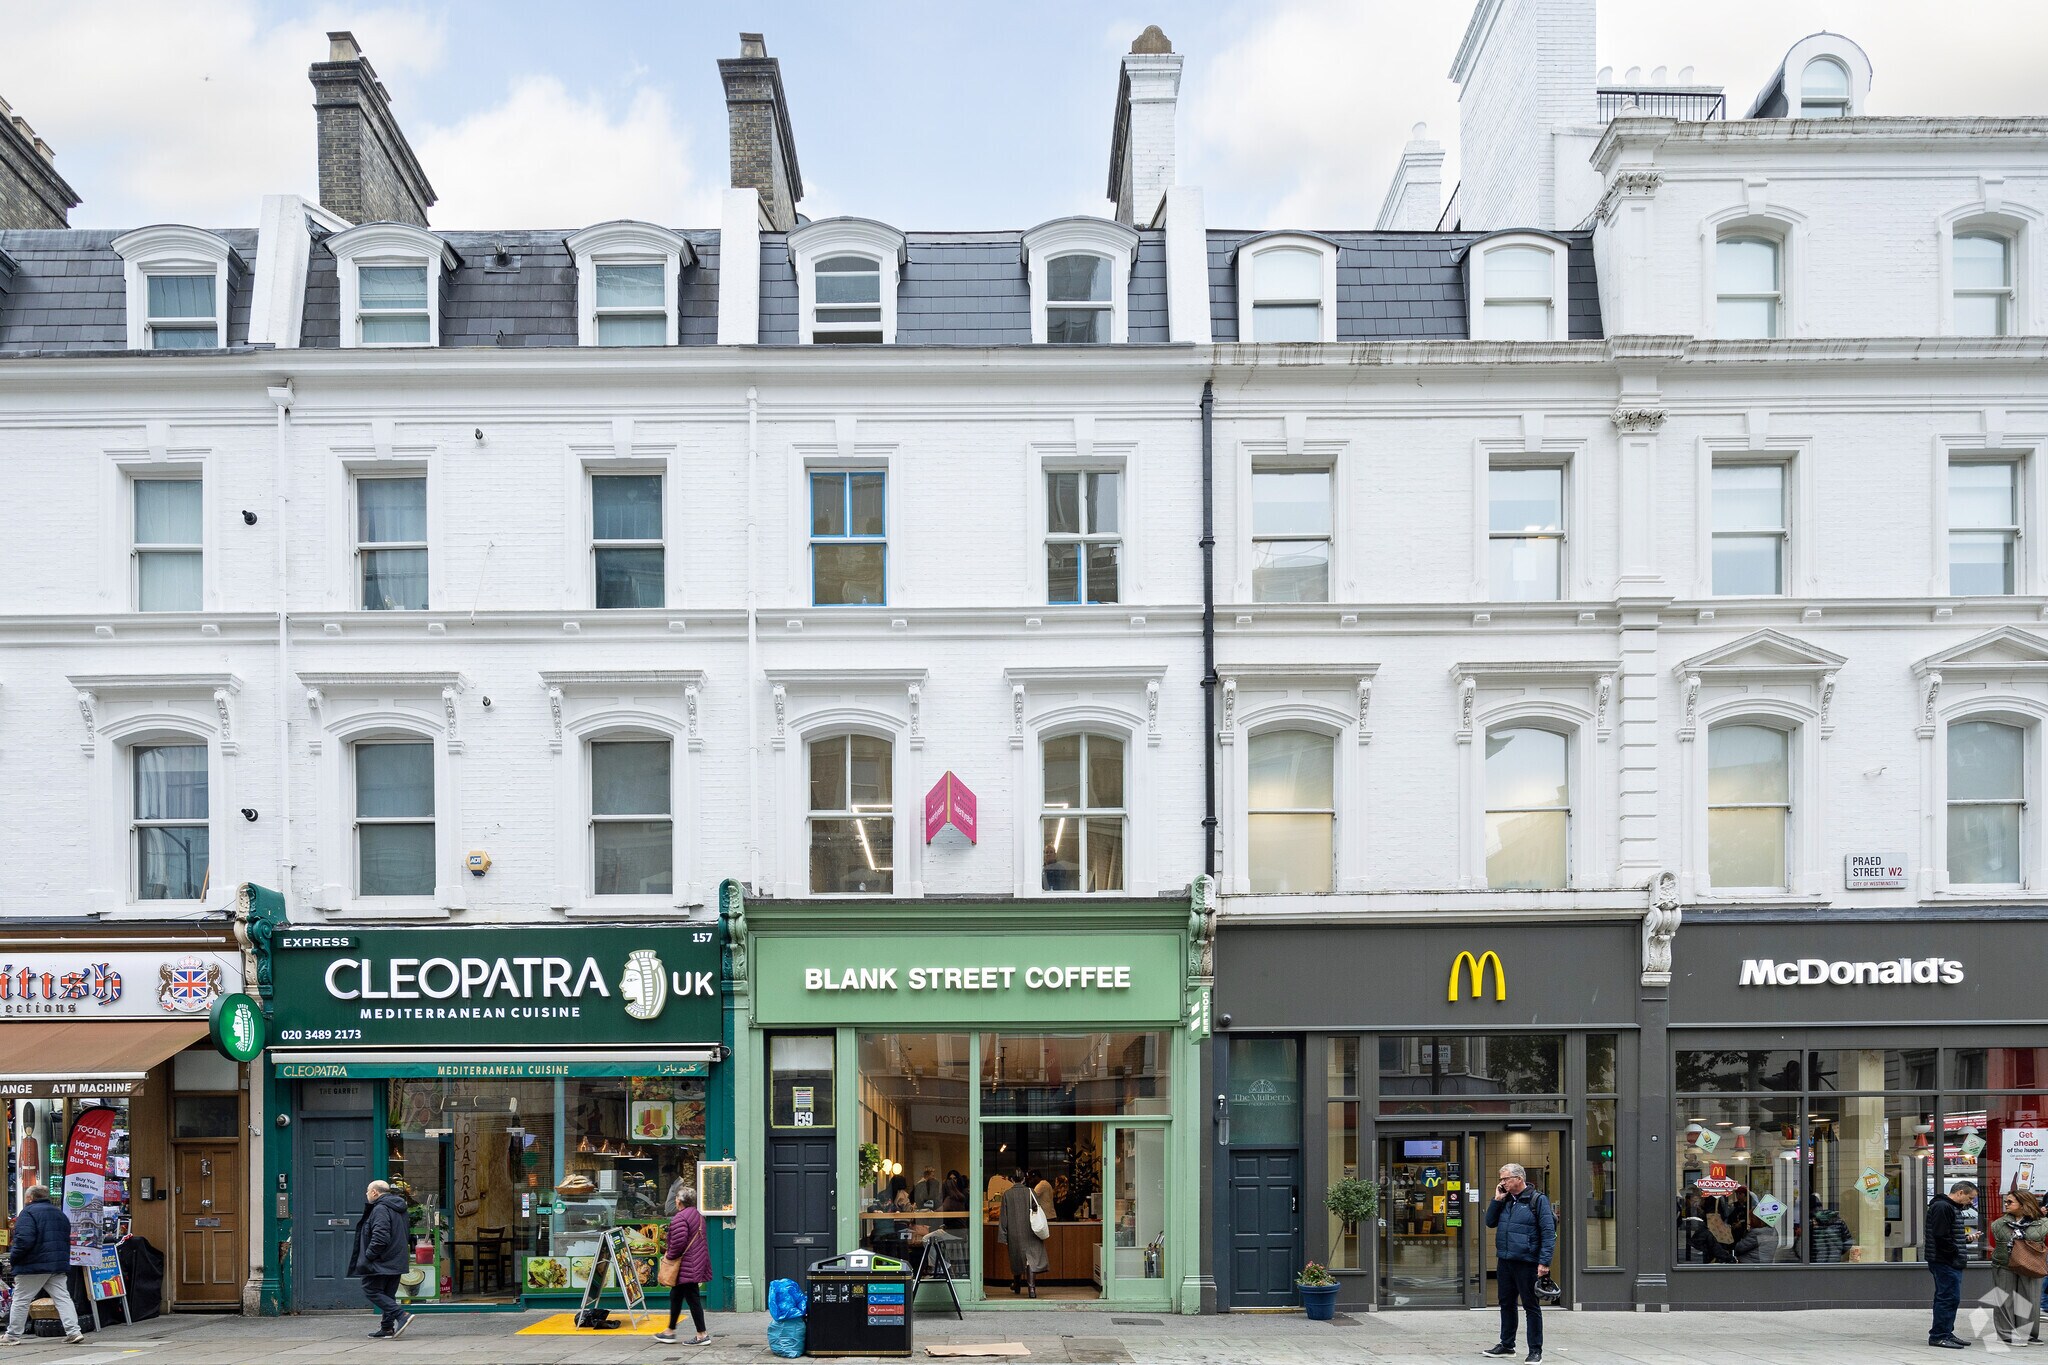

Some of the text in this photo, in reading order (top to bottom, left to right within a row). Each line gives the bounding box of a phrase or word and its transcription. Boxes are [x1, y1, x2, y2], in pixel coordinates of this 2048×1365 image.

[1852, 856, 1882, 866] PRAED
[1853, 866, 1903, 877] STREET W2
[283, 937, 350, 948] EXPRESS
[692, 932, 713, 943] 157
[1738, 957, 1965, 987] McDonald's
[324, 957, 714, 1000] CLEOPATRA UK
[805, 965, 1132, 991] BLANK STREET COFFEE
[0, 1002, 77, 1013] ections
[360, 1006, 581, 1019] MEDITERRANEAN CUISINE
[281, 1029, 362, 1040] 020 3489 2173
[283, 1065, 569, 1077] CLEOPATRA MEDITERRANEAN CUISINE
[657, 1063, 698, 1075] كليوباترا
[52, 1084, 76, 1094] ATM
[79, 1082, 132, 1093] MACHINE
[333, 1087, 359, 1095] GARRET
[1251, 1094, 1292, 1102] Mulberry
[794, 1112, 814, 1126] 159
[2018, 1131, 2034, 1139] Get
[75, 1140, 102, 1152] Hop-on
[74, 1148, 102, 1160] Hop-off
[70, 1156, 104, 1169] Bus Tours
[333, 1158, 344, 1166] 157
[71, 1182, 90, 1190] Tickets
[1698, 1180, 1737, 1188] MONOPOLY
